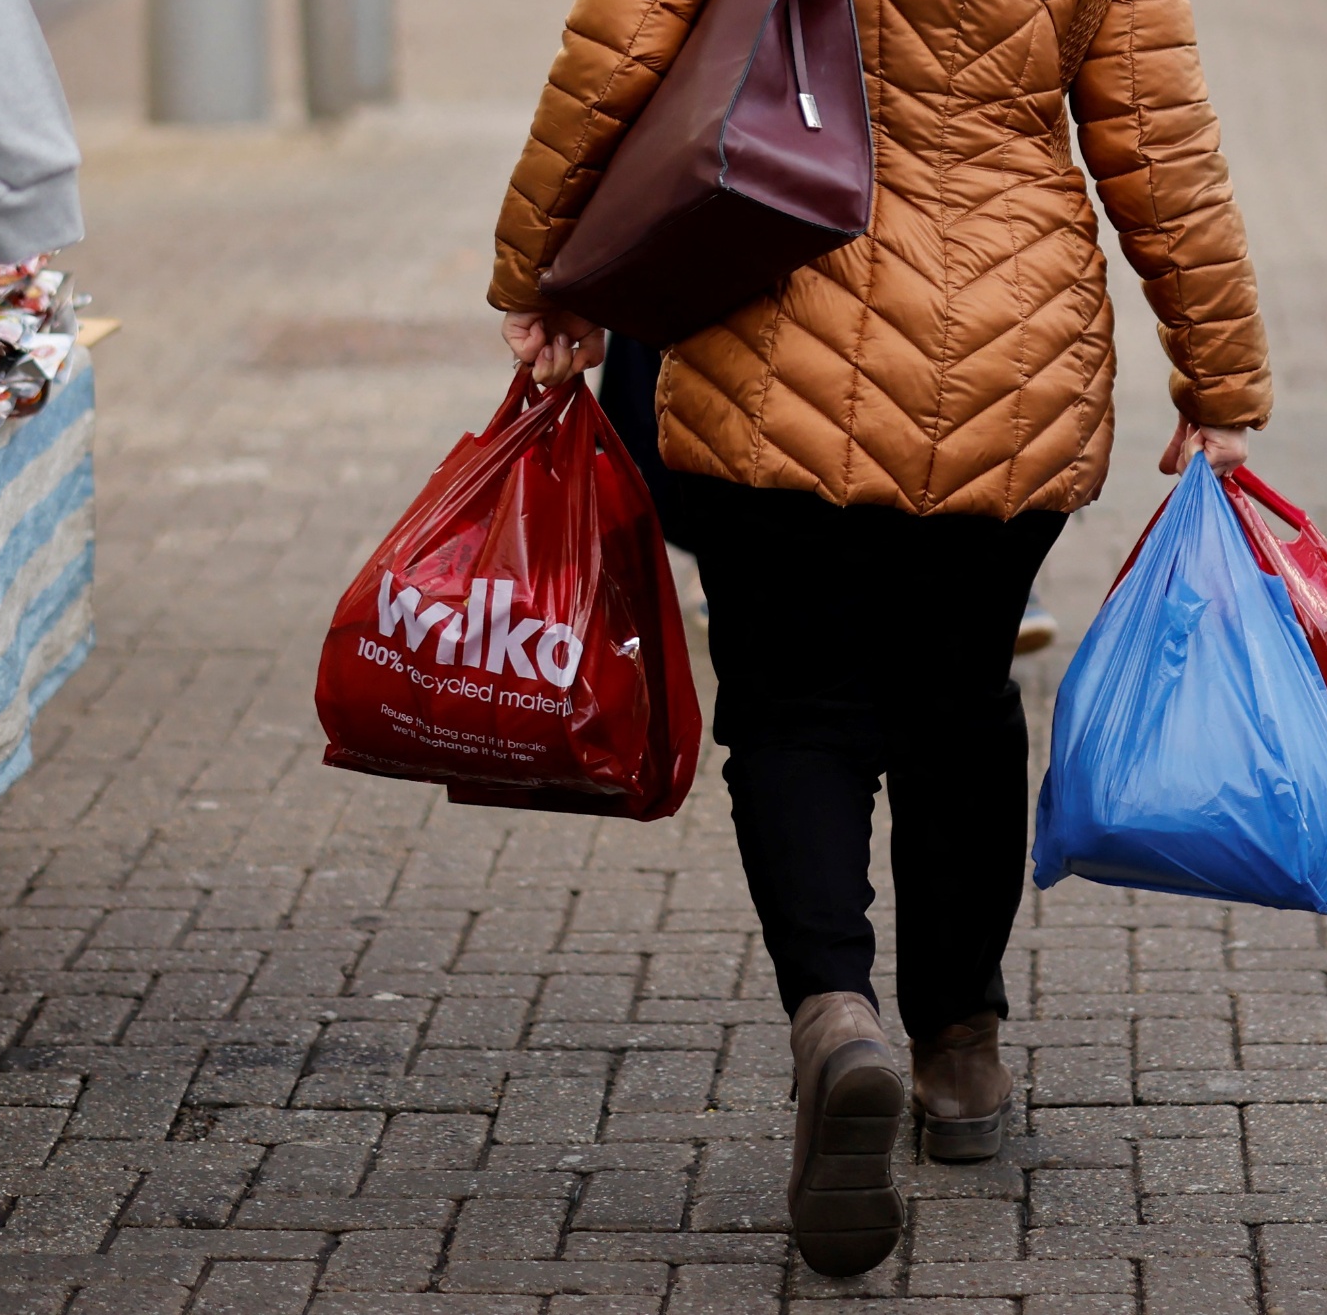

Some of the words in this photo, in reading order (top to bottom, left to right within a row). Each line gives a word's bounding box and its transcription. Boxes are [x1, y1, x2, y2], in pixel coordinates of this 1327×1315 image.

[377, 569, 584, 688] wilko
[357, 636, 404, 673] 100%
[406, 664, 494, 703] recycled
[380, 703, 414, 724] Reuse
[433, 724, 459, 740] bag
[461, 732, 486, 744] and
[497, 738, 504, 748] it
[507, 739, 547, 753] breaks
[392, 723, 416, 739] we'll
[418, 735, 479, 754] exchange
[481, 746, 489, 756] it
[491, 749, 508, 760] for
[510, 751, 535, 762] free
